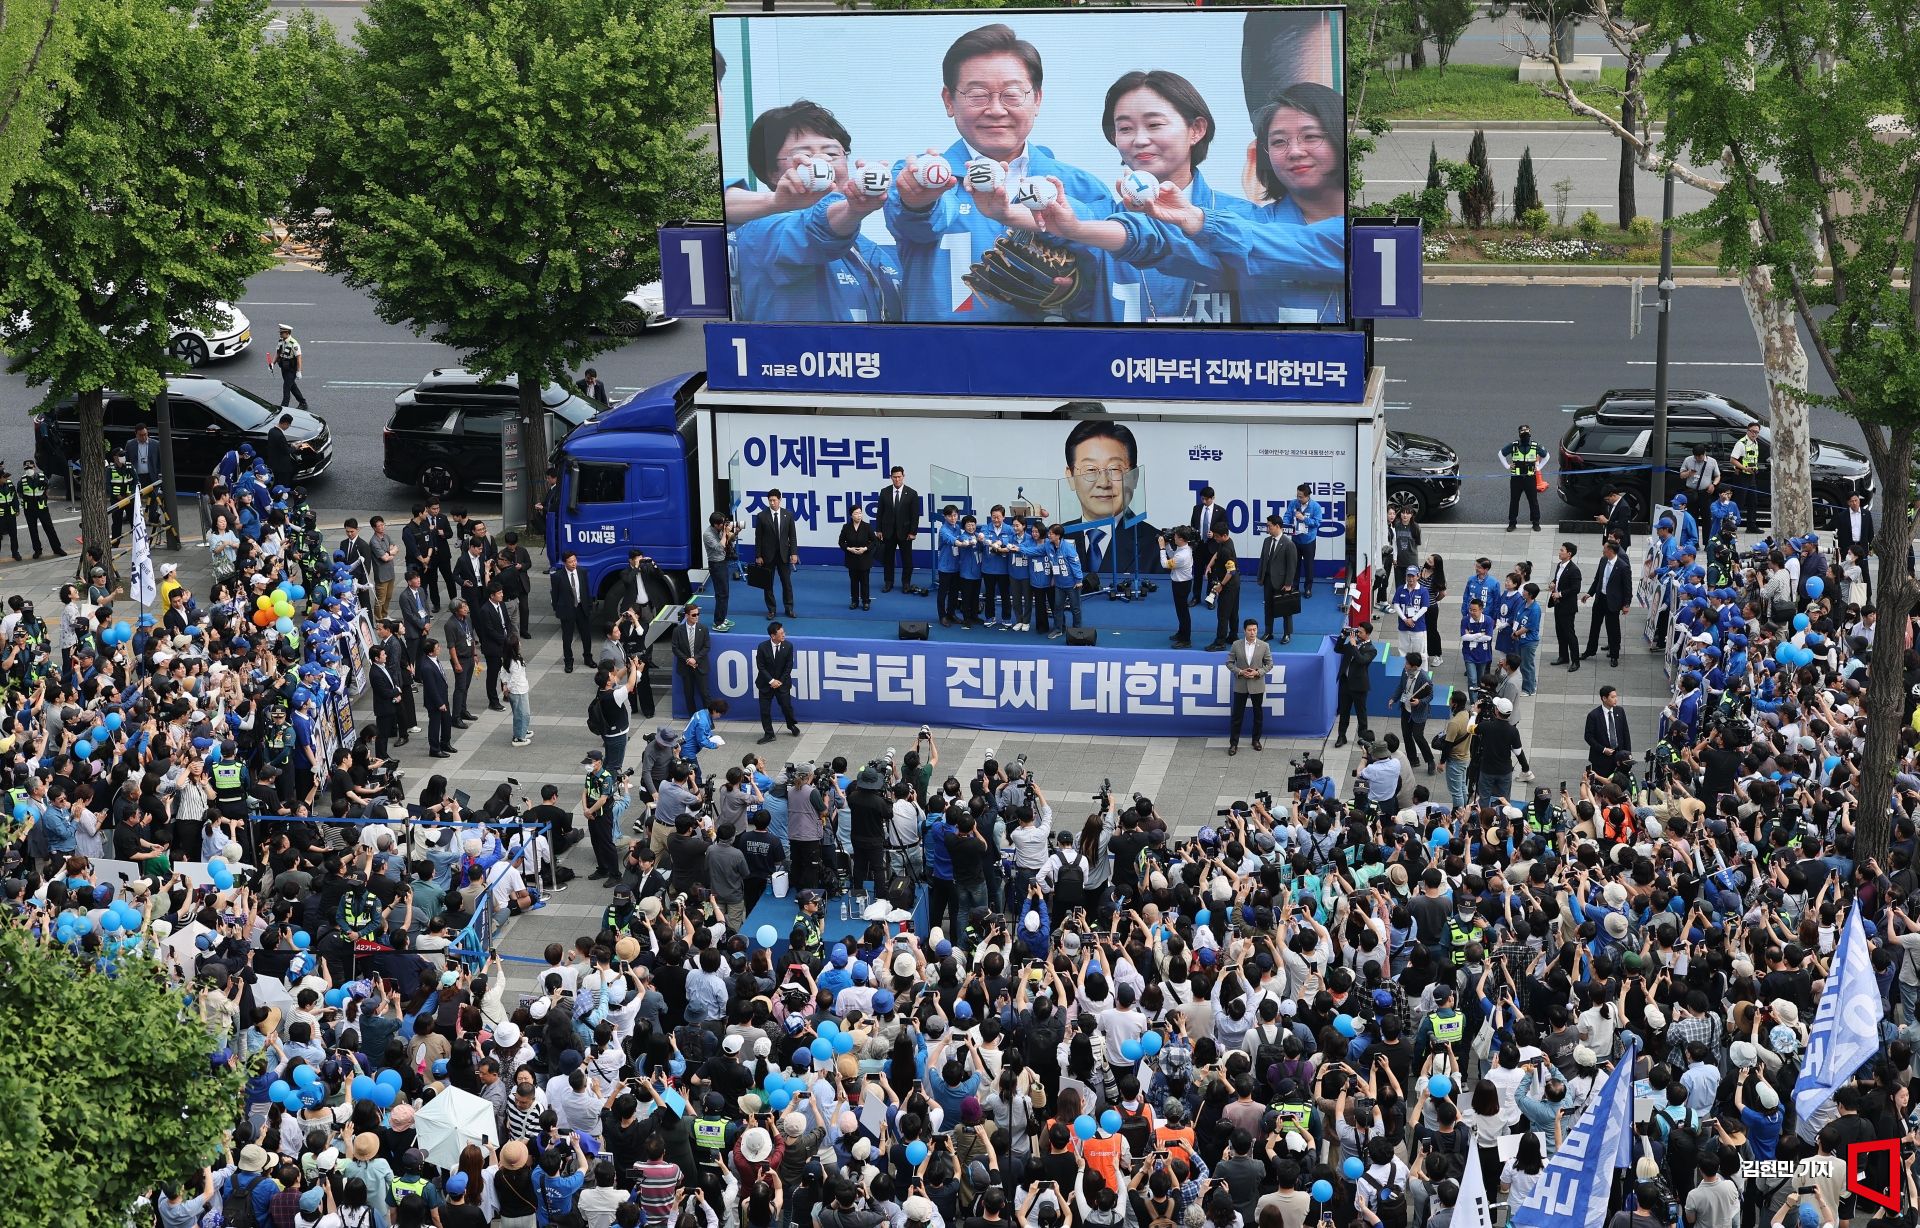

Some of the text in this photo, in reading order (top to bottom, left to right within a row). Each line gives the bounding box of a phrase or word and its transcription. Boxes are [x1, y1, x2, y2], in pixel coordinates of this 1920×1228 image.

[863, 171, 890, 193] 란
[968, 163, 991, 184] 종
[680, 239, 706, 305] 1
[1373, 238, 1397, 306] 1
[731, 337, 881, 379] 1 지금은 이재명
[1110, 357, 1348, 388] 이제부터 진짜 대한민국
[743, 434, 891, 479] 이제부터
[1188, 449, 1224, 462] 민주당
[564, 524, 616, 544] 1 이재명
[946, 656, 1054, 710] 진짜
